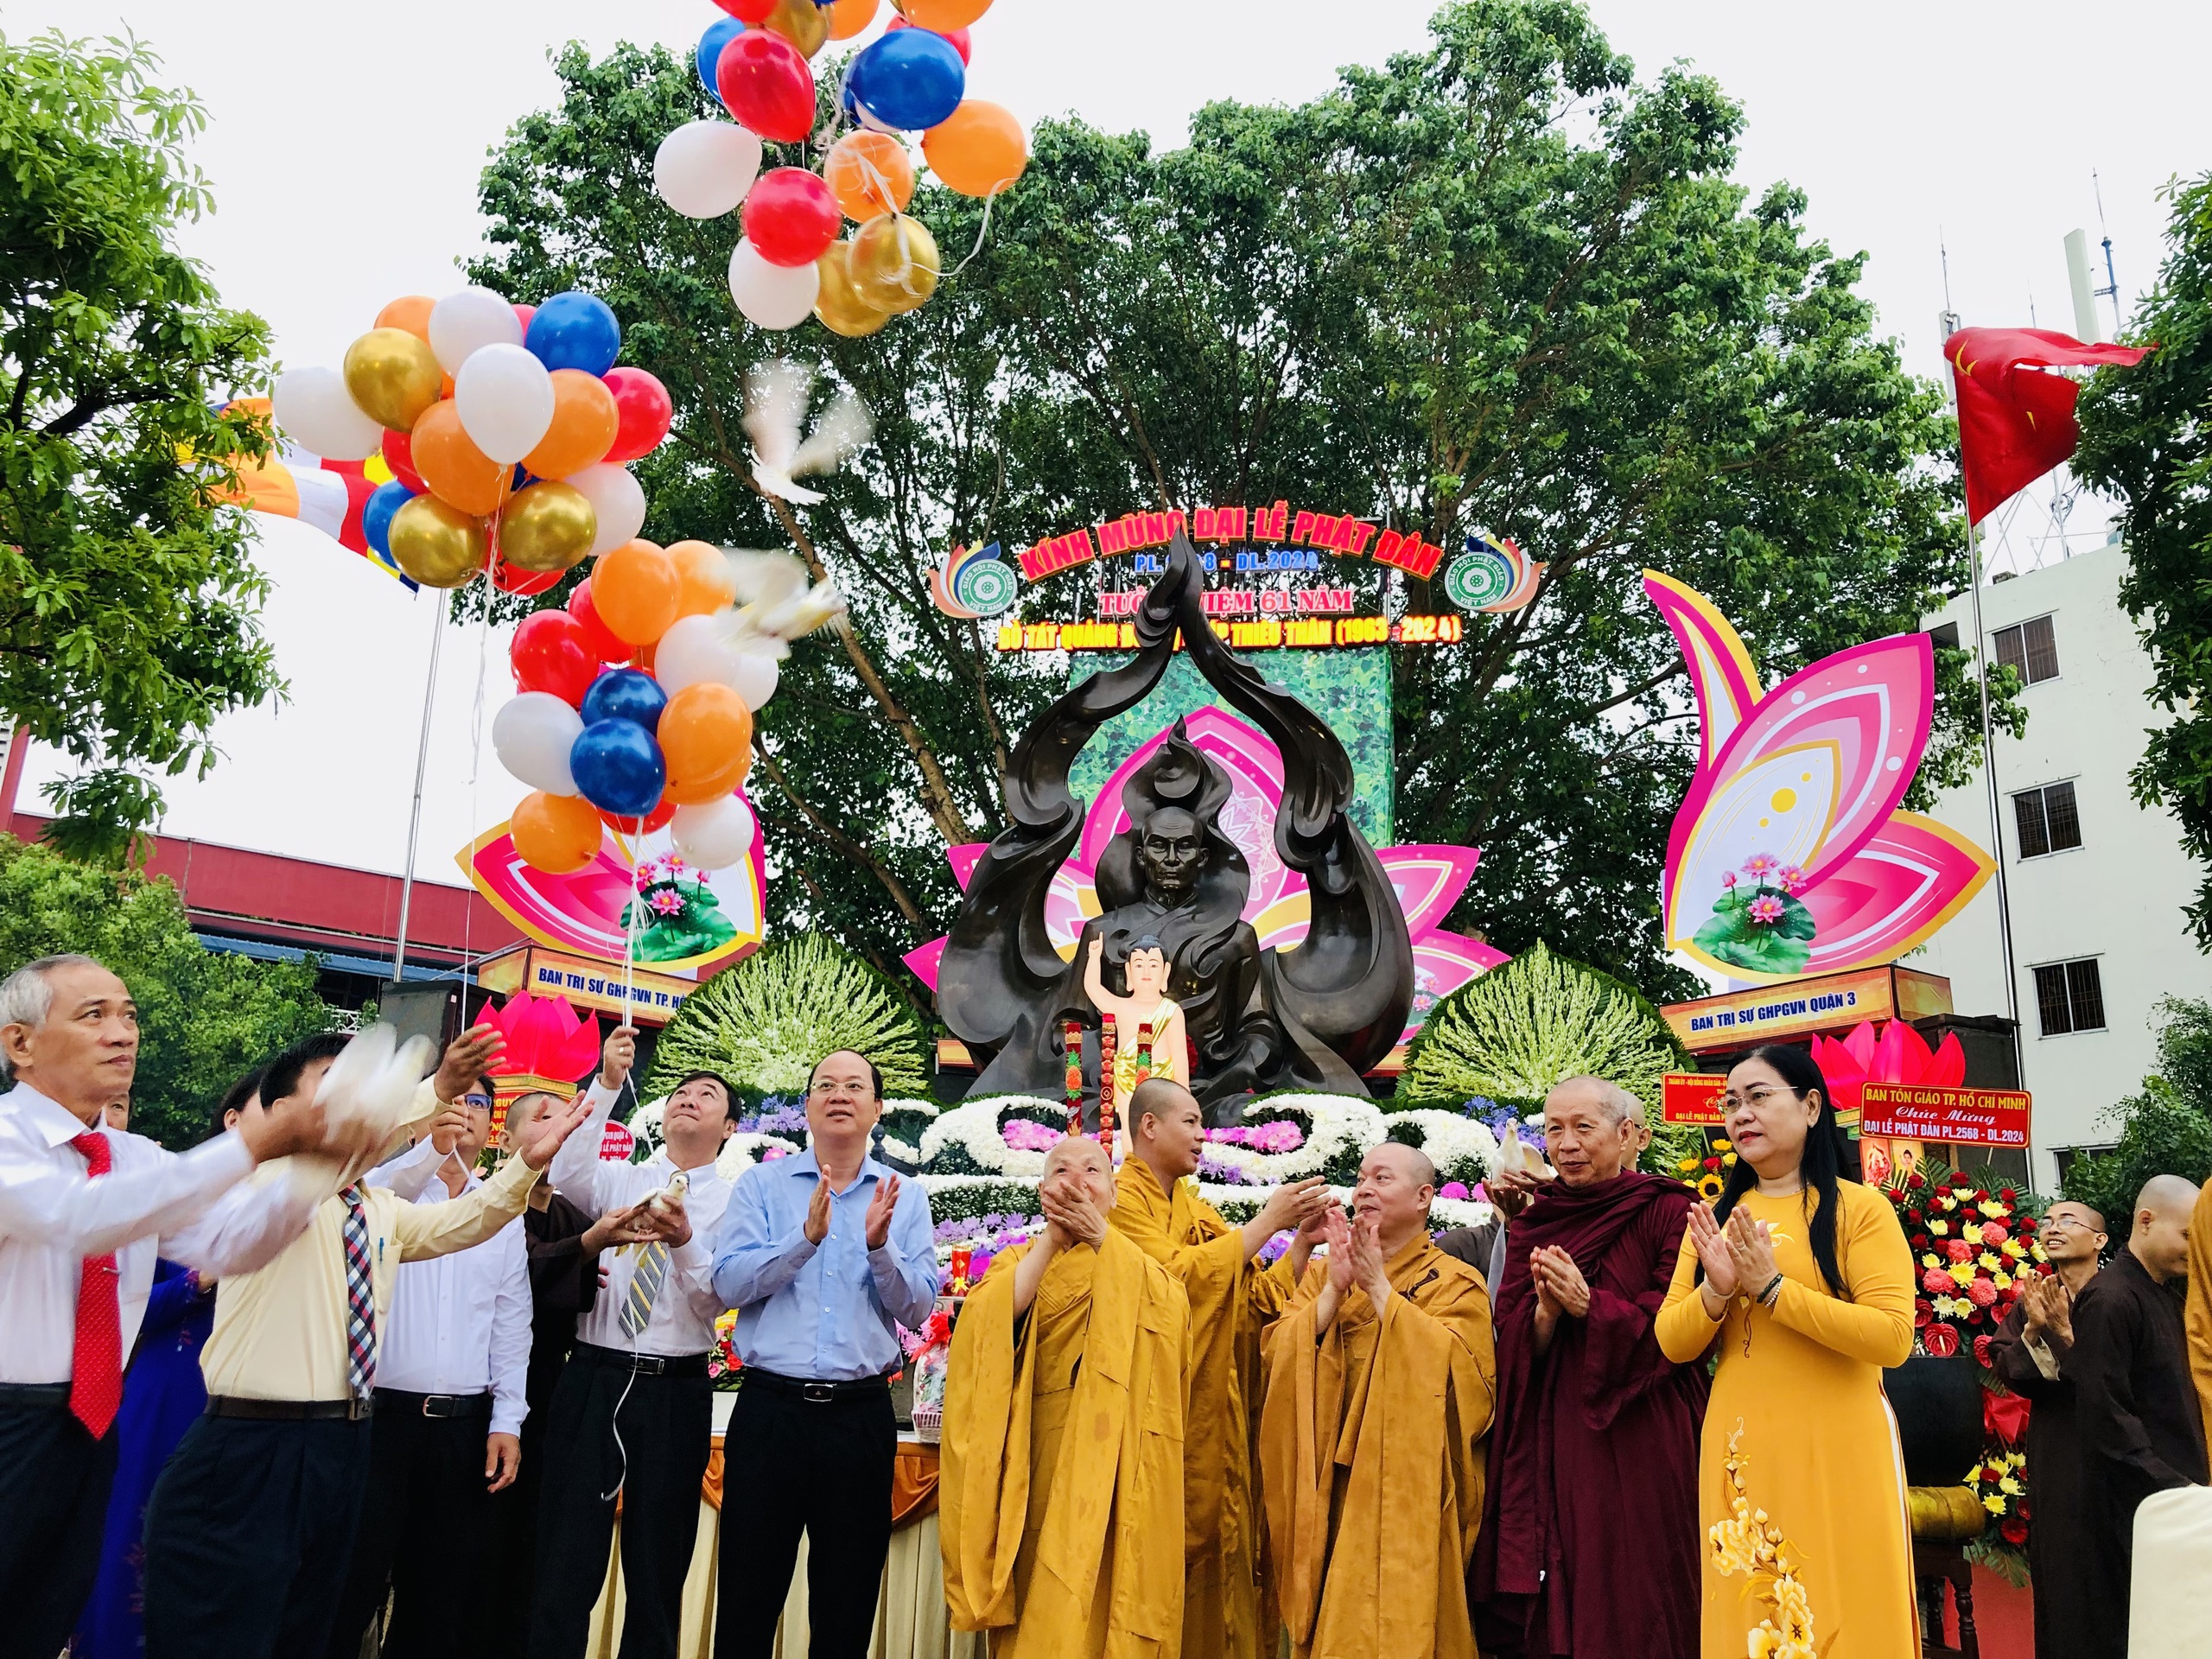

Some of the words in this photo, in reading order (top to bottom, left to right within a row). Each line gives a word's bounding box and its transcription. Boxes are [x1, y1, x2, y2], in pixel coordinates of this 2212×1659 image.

[1017, 529, 1096, 584] KÍNH
[1193, 507, 1247, 546] ĐẠI
[1253, 499, 1289, 543] LỄ
[1291, 510, 1376, 557] PHẬT
[1371, 528, 1444, 582] ĐẢN
[1236, 550, 1319, 574] DL.2024
[987, 602, 1003, 612] NAM
[1259, 590, 1292, 613] 61
[1297, 584, 1354, 614] NĂM
[1480, 594, 1497, 604] NAM
[1335, 617, 1389, 646] (1963
[1401, 614, 1462, 643] 2024)
[538, 968, 563, 985] BAN
[567, 973, 585, 992] TRỊ
[588, 978, 606, 995] SỰ
[607, 982, 652, 1003] GHPGVN
[655, 992, 668, 1007] TP.
[1691, 1016, 1713, 1031] BAN
[1717, 1012, 1735, 1027] TRỊ
[1738, 1007, 1755, 1024] SỰ
[1758, 1000, 1806, 1020] GHPGVN
[1809, 993, 1843, 1012] QUẬN
[1847, 992, 1856, 1006] 3
[1866, 1088, 1887, 1102] BAN
[1890, 1088, 1911, 1103] TÔN
[1914, 1090, 1940, 1105] GIÁO
[1942, 1094, 1956, 1107] TP.
[1959, 1091, 1975, 1107] HỒ
[1977, 1094, 1996, 1109] CHÍ
[1998, 1096, 2026, 1110] MINH
[1895, 1106, 1939, 1120] Chúc
[1942, 1109, 1997, 1125] Mừng
[1864, 1120, 1880, 1135] ĐẠI
[1882, 1117, 1893, 1133] LỄ
[1895, 1120, 1918, 1138] PHẬT
[1920, 1121, 1939, 1136] ĐẢN
[1942, 1126, 1979, 1140] PL.2568
[1987, 1129, 2024, 1142] DL.2024
